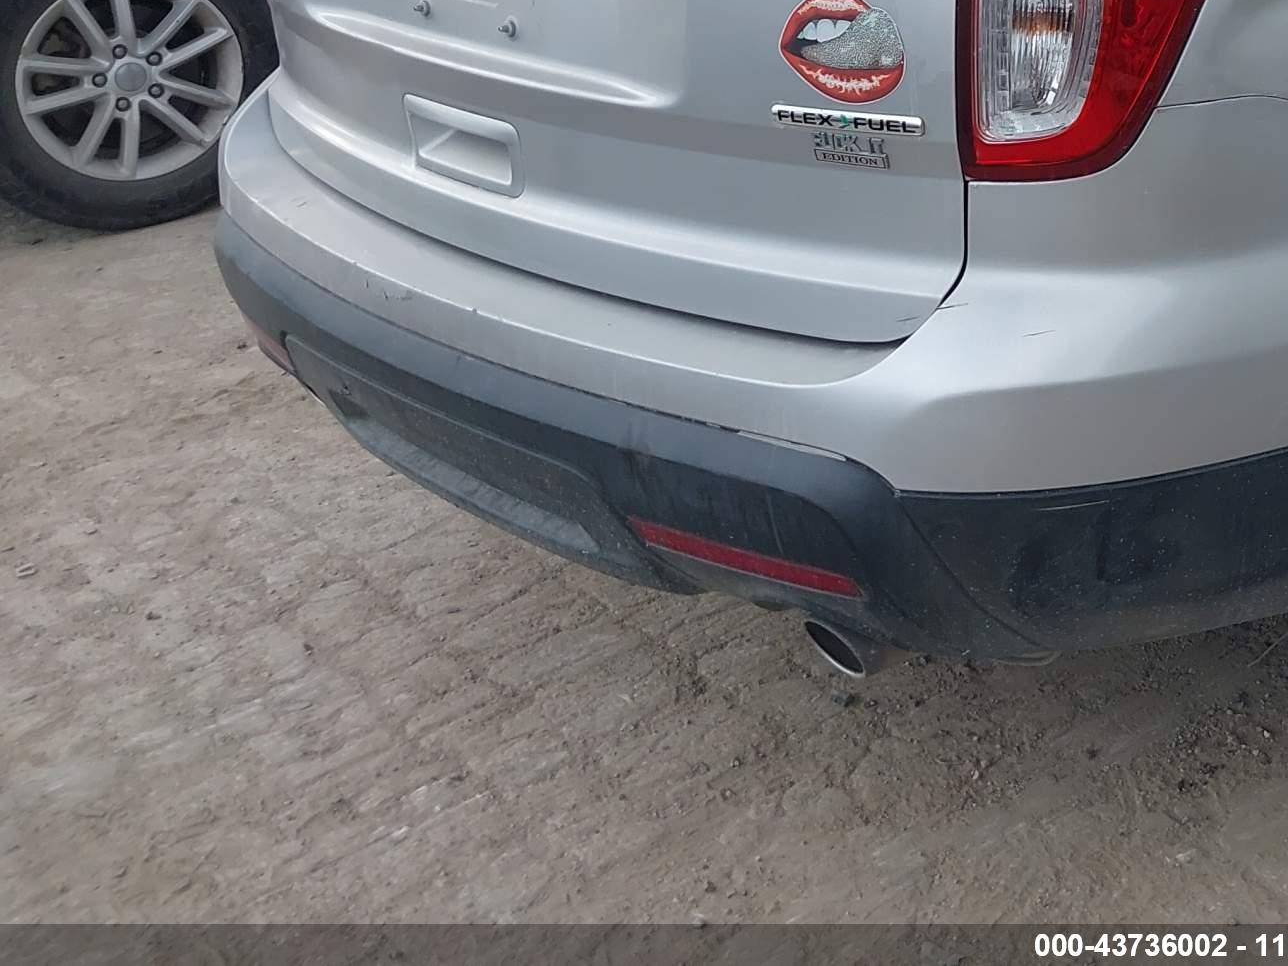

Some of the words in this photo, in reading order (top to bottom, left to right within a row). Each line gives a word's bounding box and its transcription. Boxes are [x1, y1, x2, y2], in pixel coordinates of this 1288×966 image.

[777, 109, 834, 127] FLEX
[853, 117, 918, 134] FUEL
[821, 151, 878, 167] EDITION
